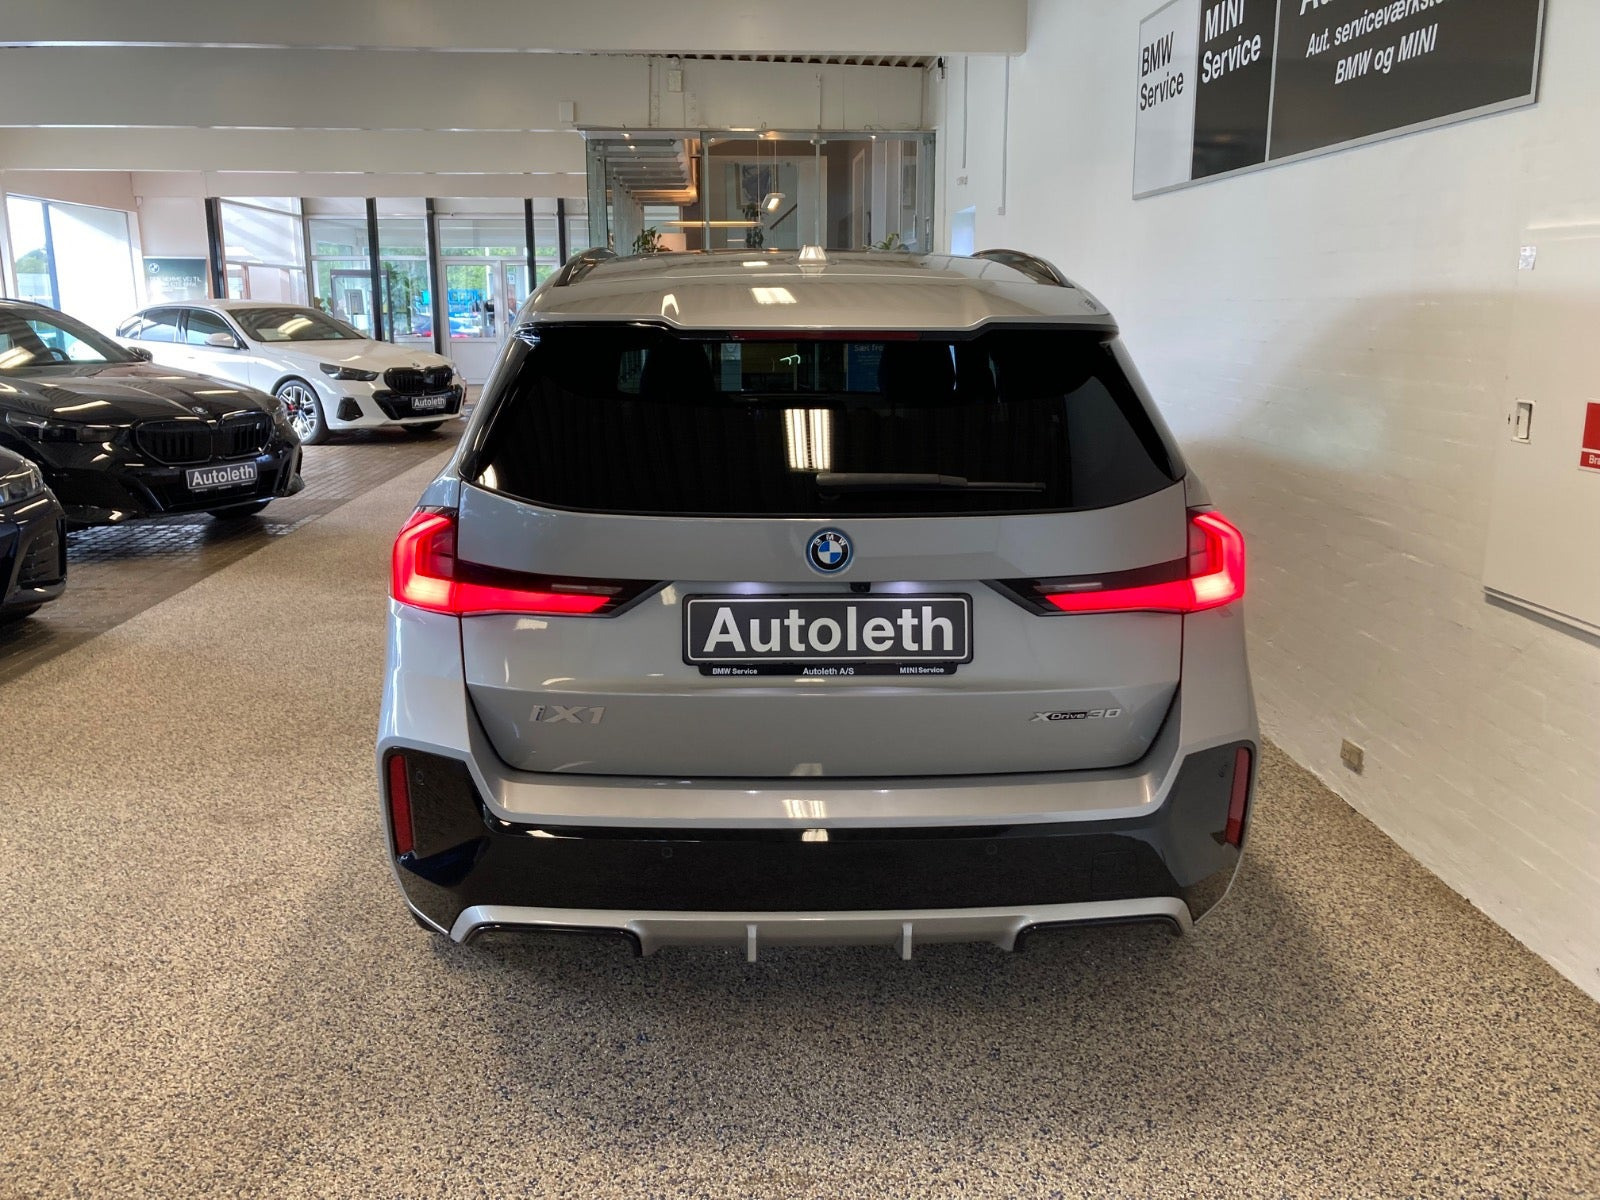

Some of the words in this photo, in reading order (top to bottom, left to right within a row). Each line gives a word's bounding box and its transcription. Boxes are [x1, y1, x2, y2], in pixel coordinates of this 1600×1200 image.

[1204, 0, 1245, 42] MINI
[1141, 31, 1174, 77] BMW
[1306, 28, 1330, 58] Aut.
[1335, 48, 1373, 85] BMW
[1374, 46, 1394, 74] og
[1397, 23, 1438, 63] MINI
[1201, 35, 1261, 83] Service
[1140, 72, 1184, 111] Service
[414, 396, 445, 407] Autoleth
[192, 465, 254, 486] Autoleth
[815, 534, 847, 546] BMW
[703, 606, 954, 653] Autoleth
[712, 667, 731, 675] BMW
[732, 667, 758, 675] Service
[803, 667, 838, 675] Autoleth
[839, 667, 855, 675] A/S
[900, 666, 918, 674] MINI
[918, 666, 945, 674] Service
[528, 705, 607, 724] iX1
